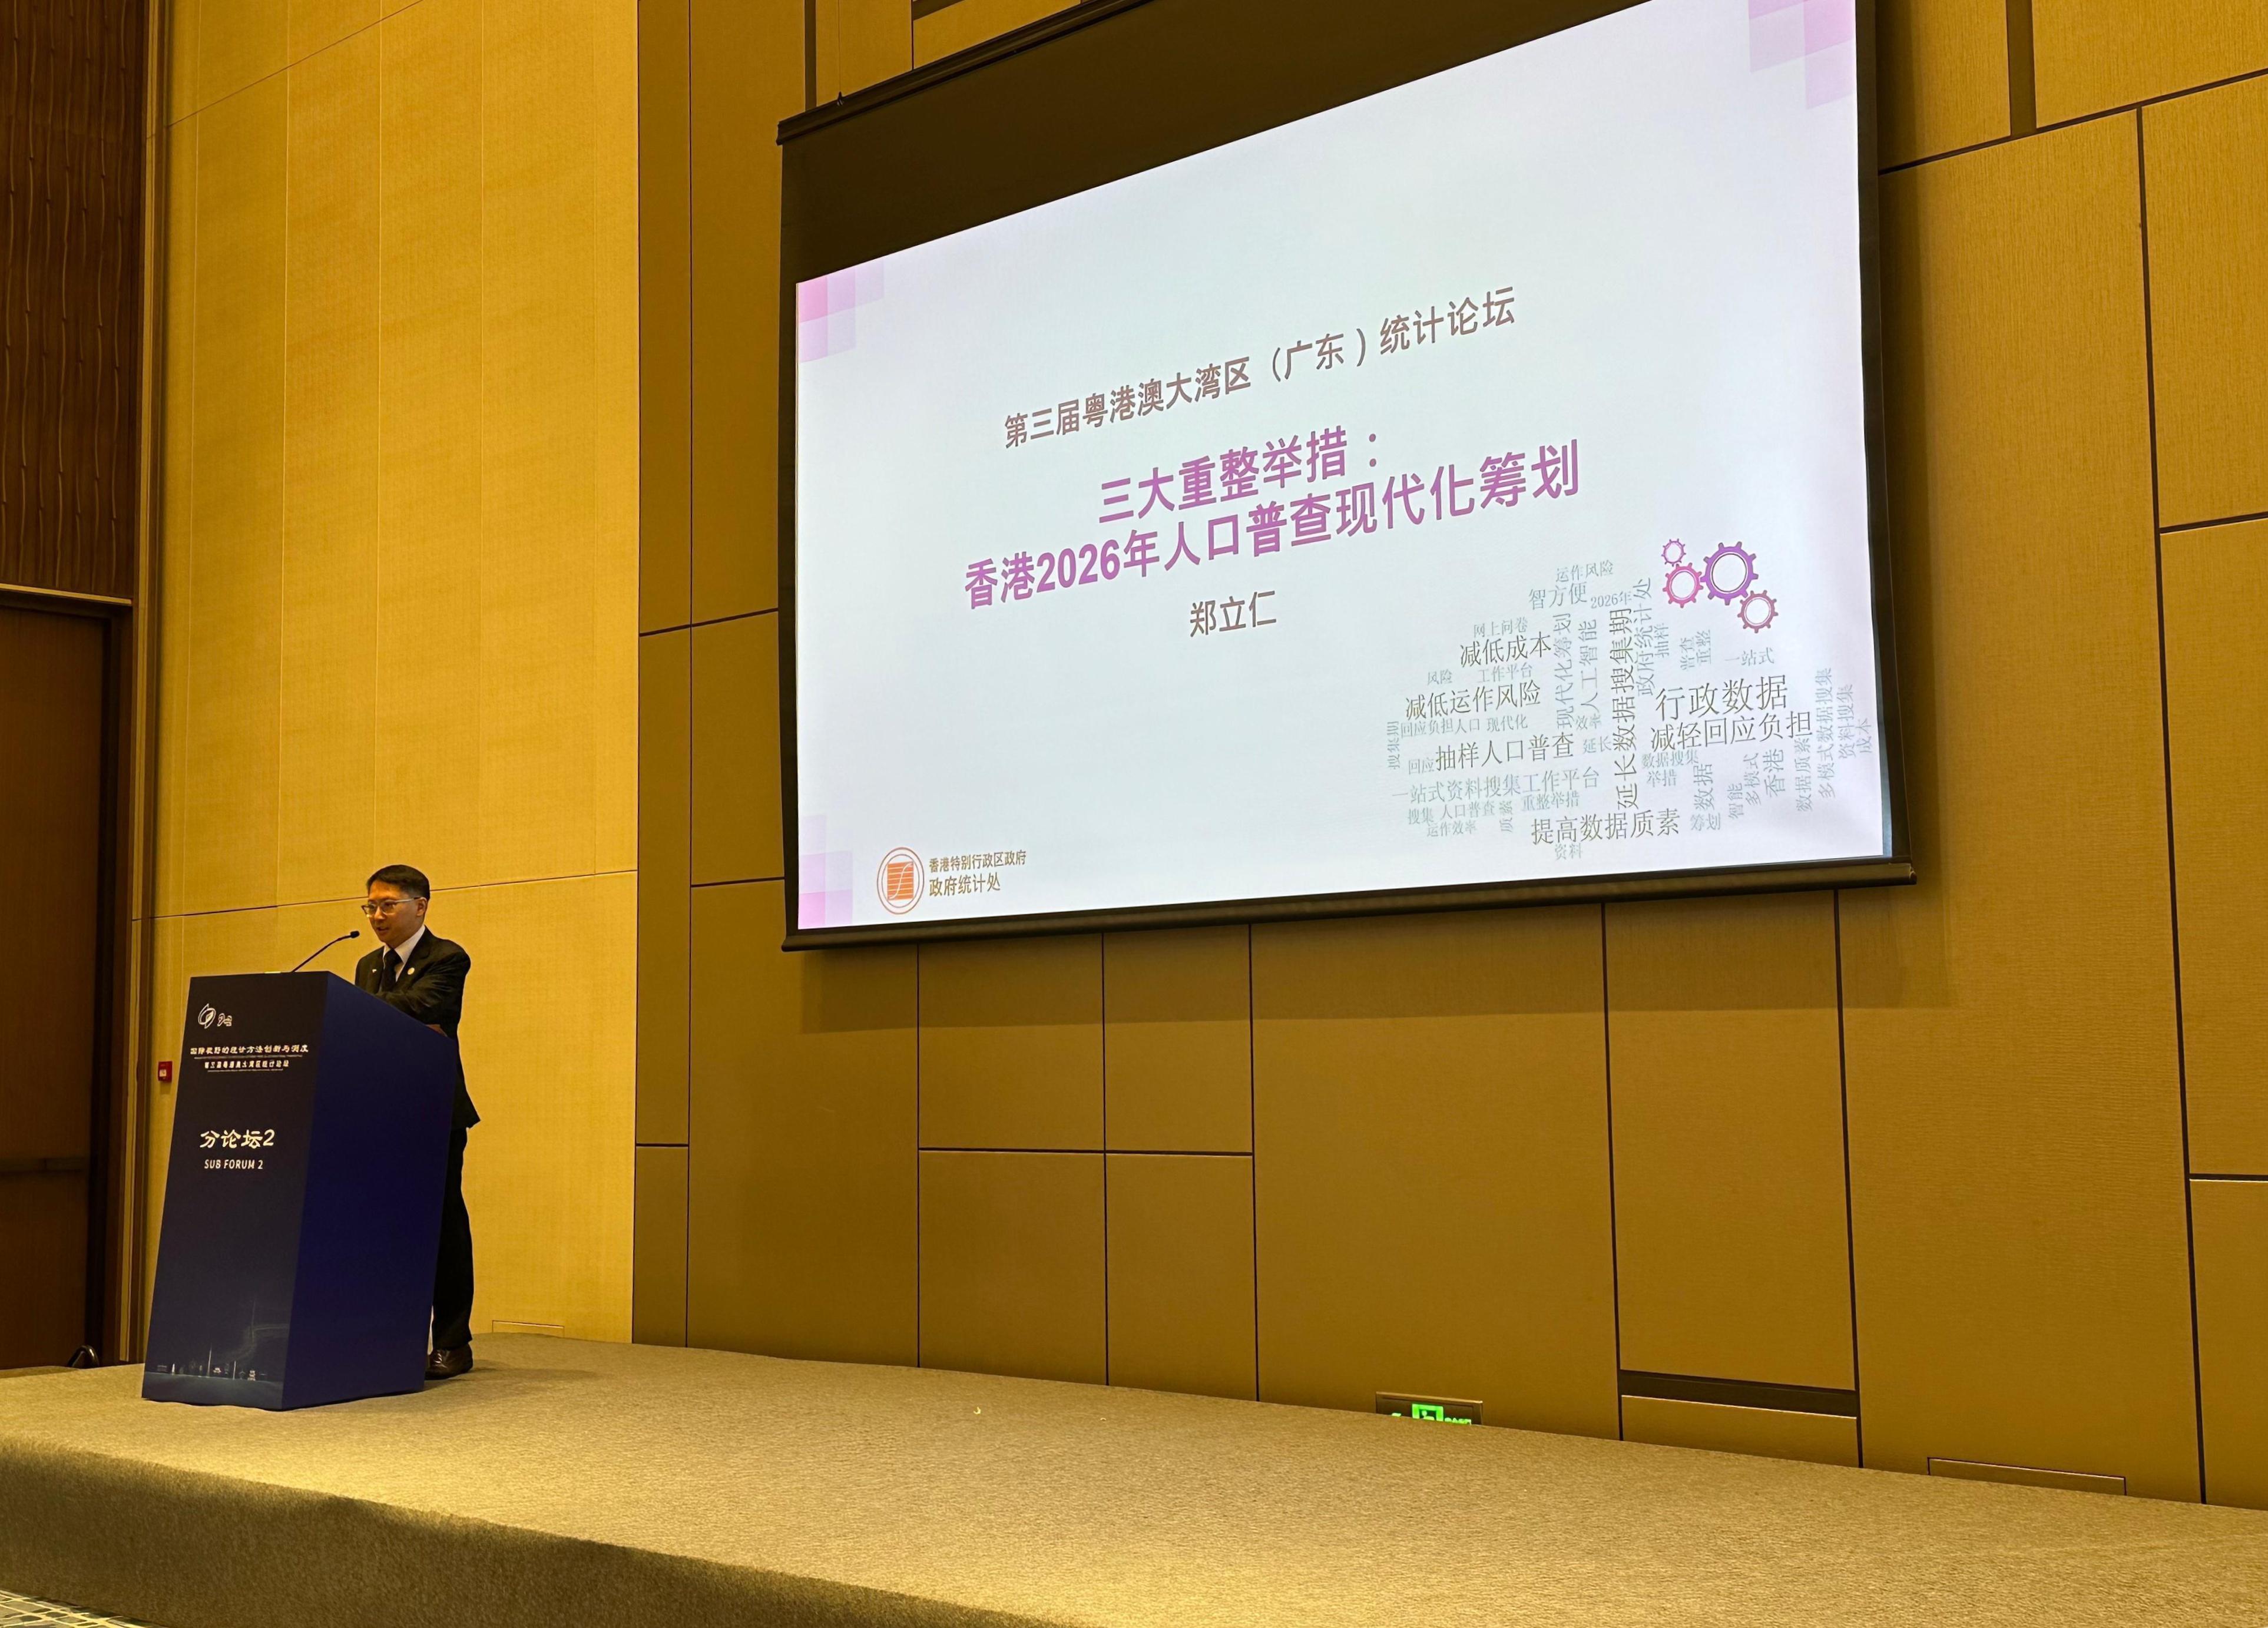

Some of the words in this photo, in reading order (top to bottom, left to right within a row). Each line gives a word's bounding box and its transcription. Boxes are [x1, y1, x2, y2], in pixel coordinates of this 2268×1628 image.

[1099, 426, 1382, 525] 三大重整举措：
[964, 439, 1580, 610] 香港2026年人口普查现代化筹划
[1555, 560, 1613, 582] 运作风险
[1190, 590, 1277, 638] 郑立仁
[1528, 582, 1588, 610] 智方便
[1590, 591, 1632, 609] 2026年
[1474, 617, 1528, 638] 网上问卷
[1633, 577, 1656, 696] 政府统计处
[1460, 631, 1552, 669] 减低成本
[1578, 619, 1600, 713] 人工智能
[1724, 647, 1775, 667] 一站式
[1477, 662, 1533, 683] 工作平台
[1553, 613, 1574, 729] 现代化筹划
[1405, 679, 1541, 721] 减低运作风险
[1609, 608, 1638, 810] 延长数据搜集期
[1656, 674, 1788, 722] 行政数据
[1651, 710, 1813, 753] 减轻回应负担
[1408, 757, 1435, 775] 回应
[1435, 732, 1574, 772] 抽样人口普查
[1693, 763, 1714, 811] 数据
[1743, 753, 1761, 806] 多模式
[1763, 748, 1786, 798] 香港
[1531, 807, 1680, 845] 提高数据质素
[929, 849, 1027, 873] 香港特别行政区政府
[929, 871, 1001, 897] 政府统计处
[200, 1129, 276, 1149] 分论坛2
[204, 1159, 221, 1170] SUB
[224, 1159, 255, 1170] FORUM
[257, 1159, 263, 1170] 2
